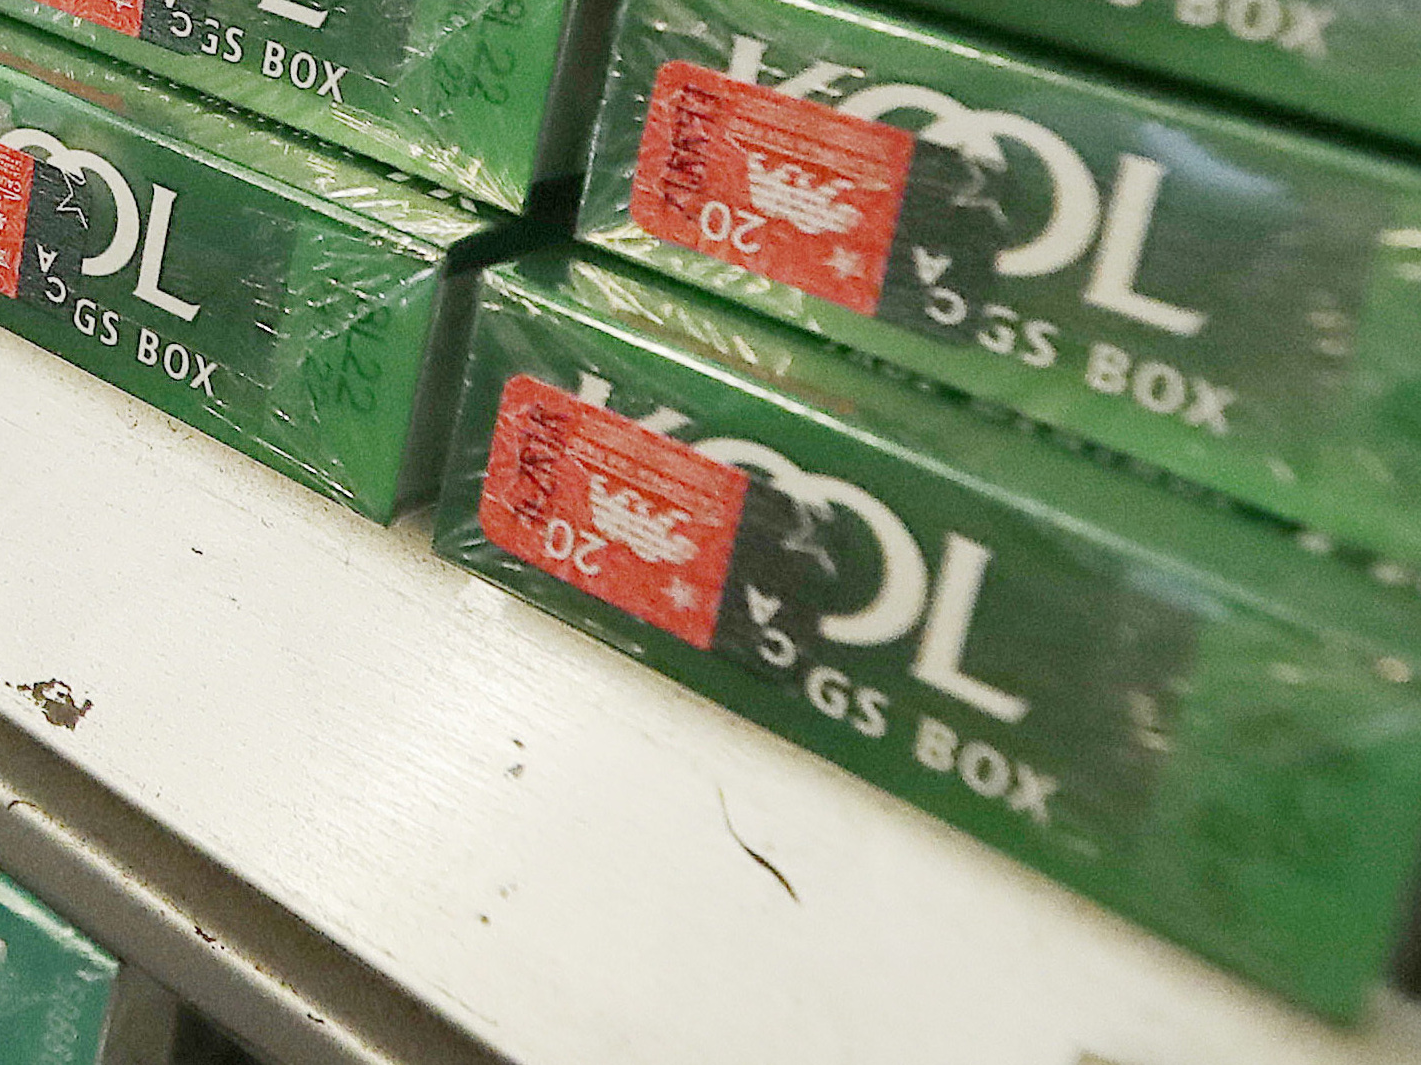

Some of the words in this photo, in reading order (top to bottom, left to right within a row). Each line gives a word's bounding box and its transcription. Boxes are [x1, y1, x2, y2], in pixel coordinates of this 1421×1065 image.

[262, 40, 348, 103] BOX
[699, 201, 767, 253] 20
[135, 329, 218, 396] BOX
[1084, 343, 1236, 435] BOX
[545, 519, 607, 575] 20
[911, 720, 1063, 823] BOX
